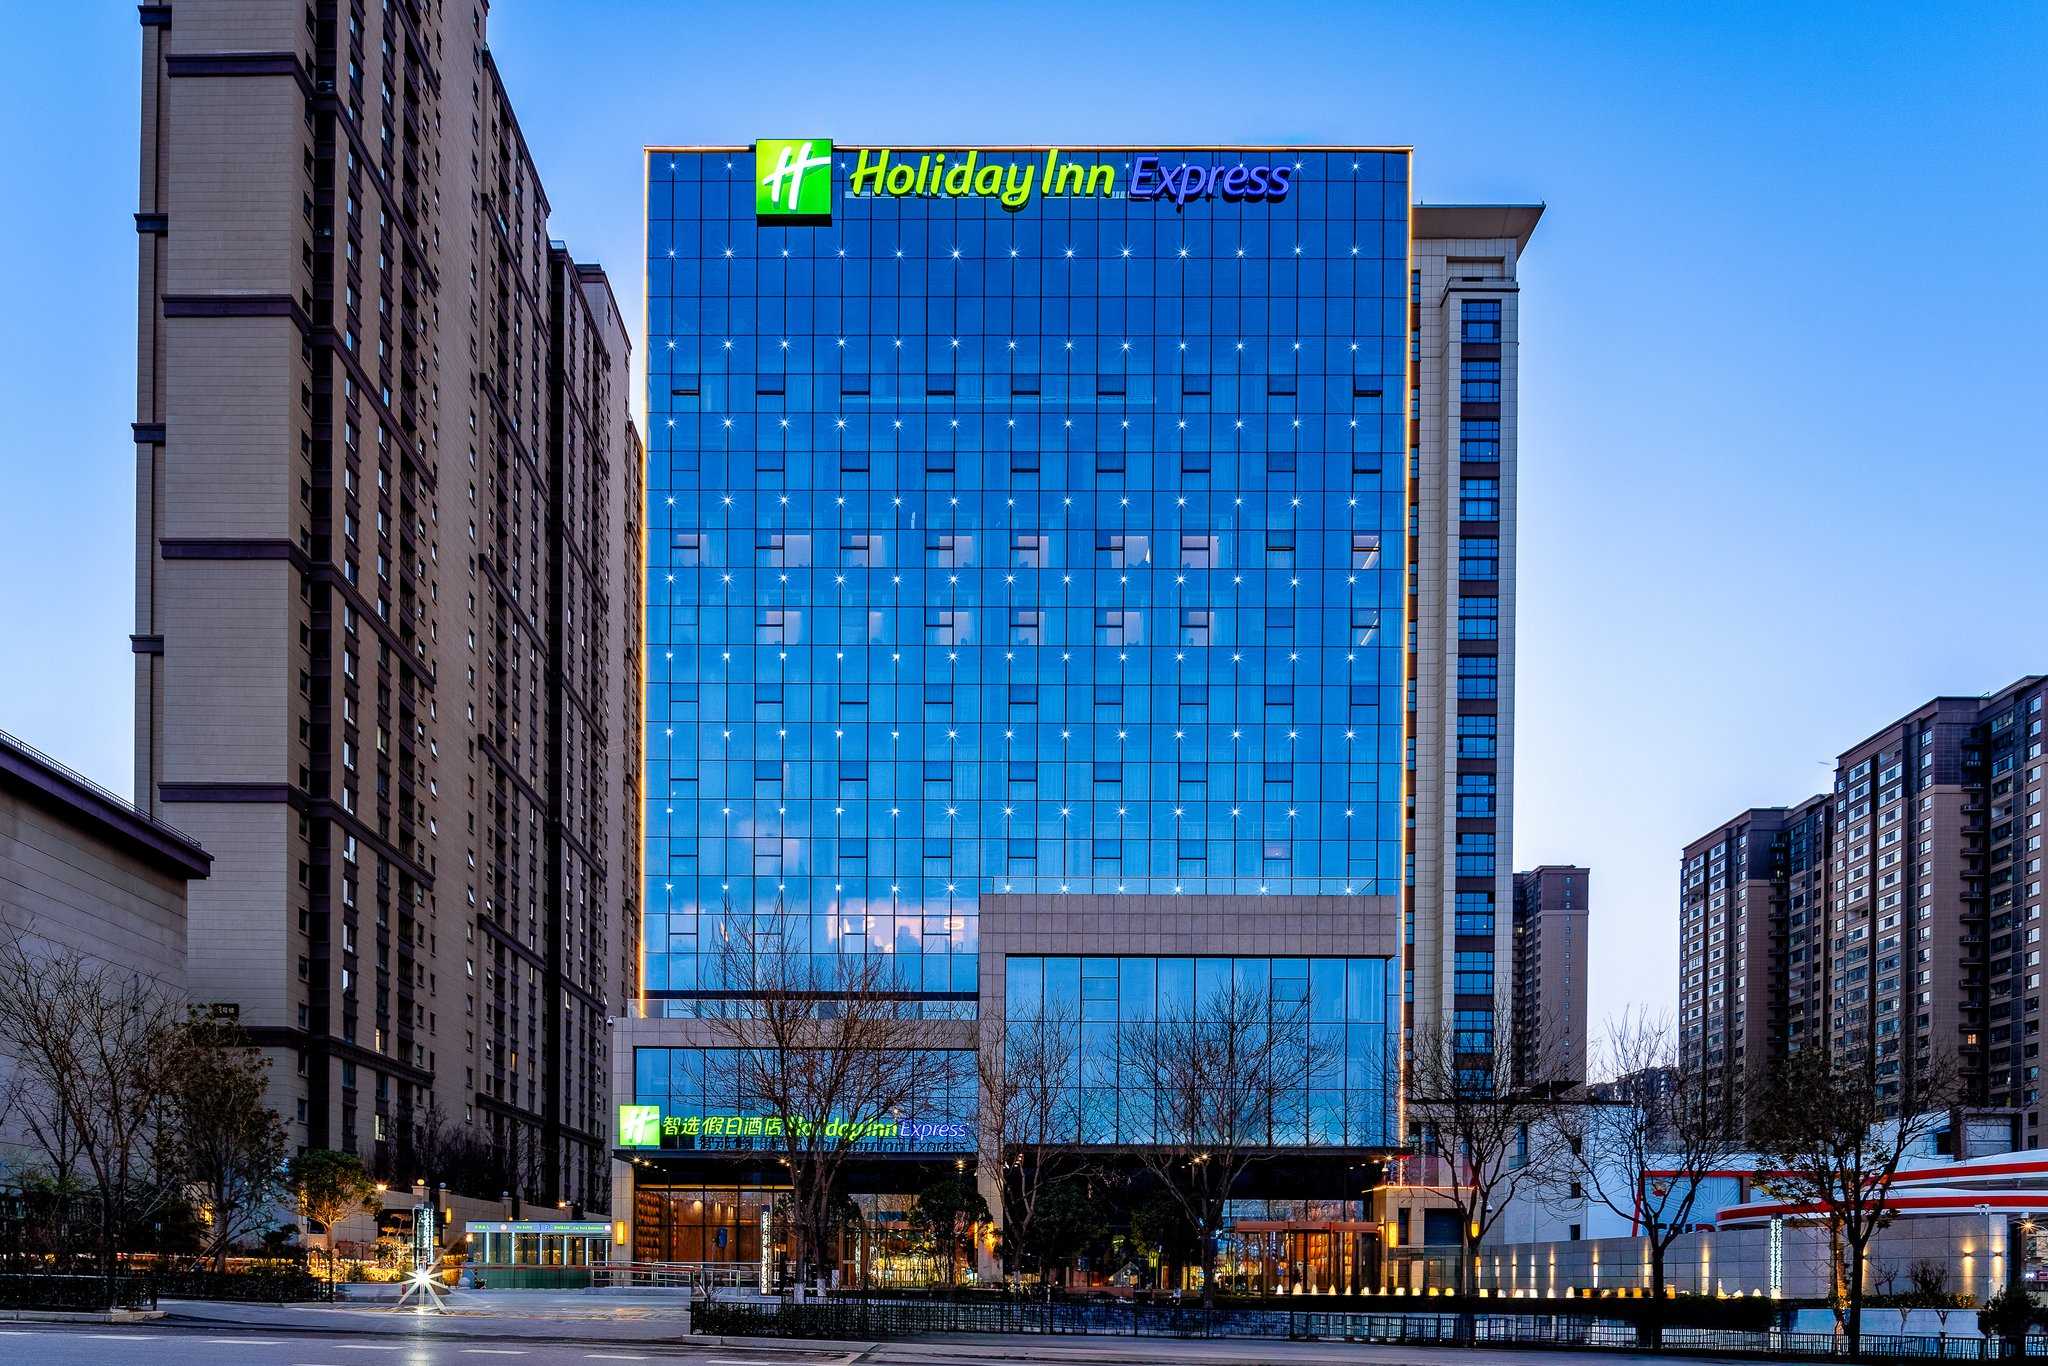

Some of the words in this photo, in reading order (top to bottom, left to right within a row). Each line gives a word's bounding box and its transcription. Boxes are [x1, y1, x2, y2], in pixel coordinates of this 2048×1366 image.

[849, 149, 1034, 207] Holiday
[1043, 149, 1116, 195] Inn
[1129, 156, 1292, 205] Express
[662, 1115, 783, 1136] 智选假日酒店
[900, 1120, 967, 1141] Express
